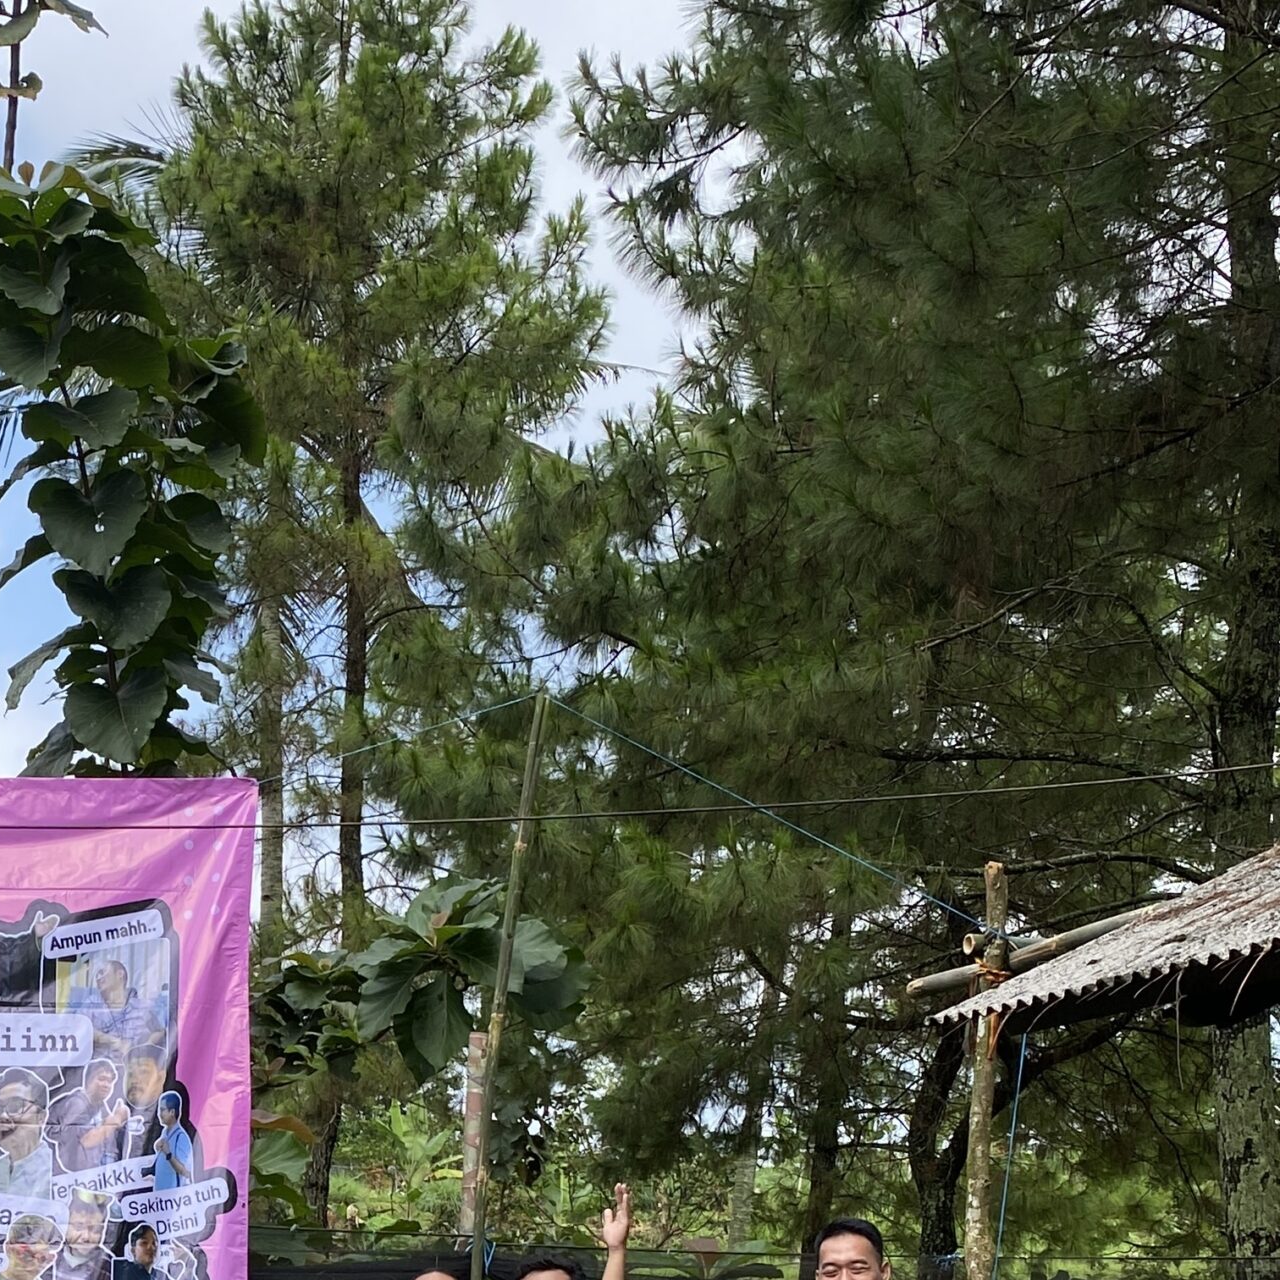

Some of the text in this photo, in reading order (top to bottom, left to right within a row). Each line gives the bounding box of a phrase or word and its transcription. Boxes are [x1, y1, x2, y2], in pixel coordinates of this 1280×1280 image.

[50, 919, 157, 951] Ampun mahh..
[128, 1184, 222, 1216] Sakitnya tuh
[155, 1212, 199, 1235] Disini
